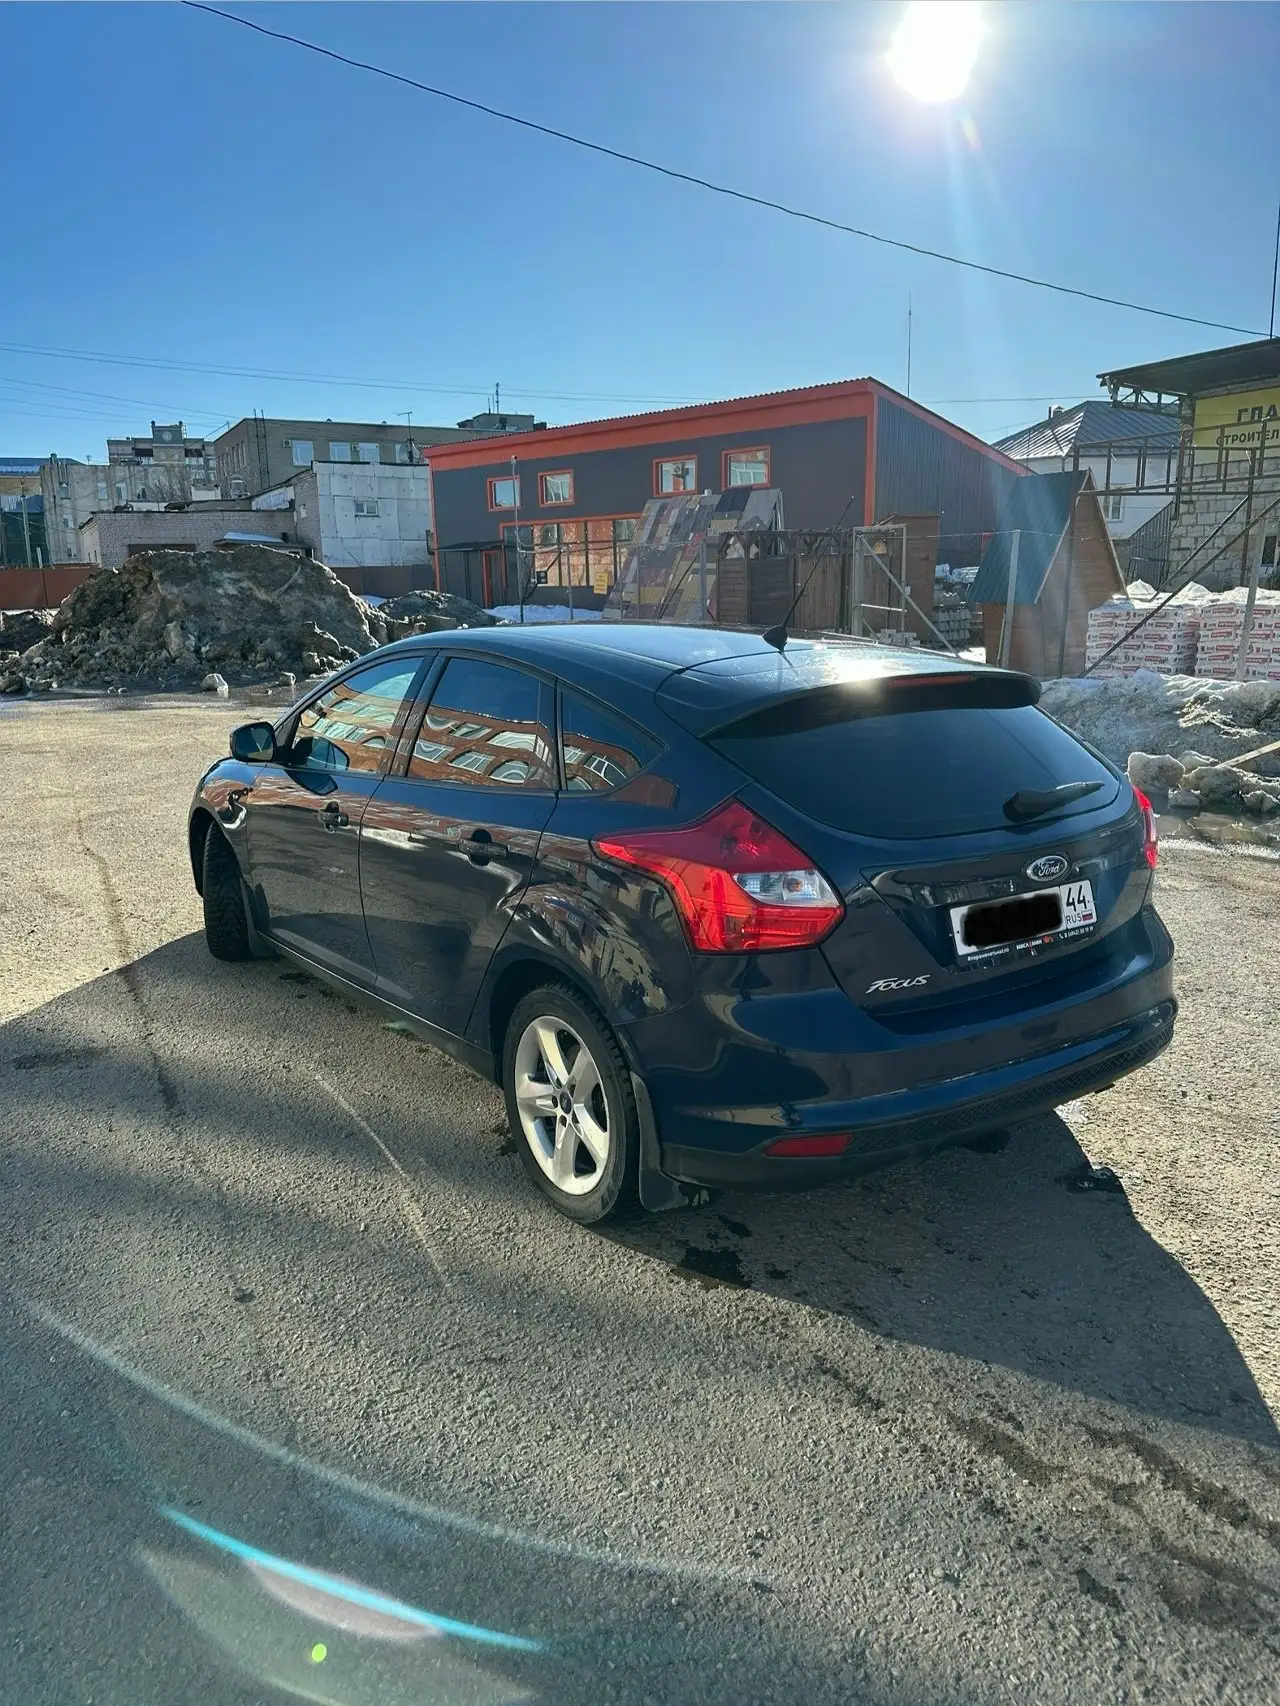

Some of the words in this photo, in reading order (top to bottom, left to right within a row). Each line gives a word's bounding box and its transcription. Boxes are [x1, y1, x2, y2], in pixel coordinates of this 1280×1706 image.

[1038, 859, 1061, 877] Ford
[1066, 885, 1087, 912] 44
[1066, 913, 1082, 925] RUS
